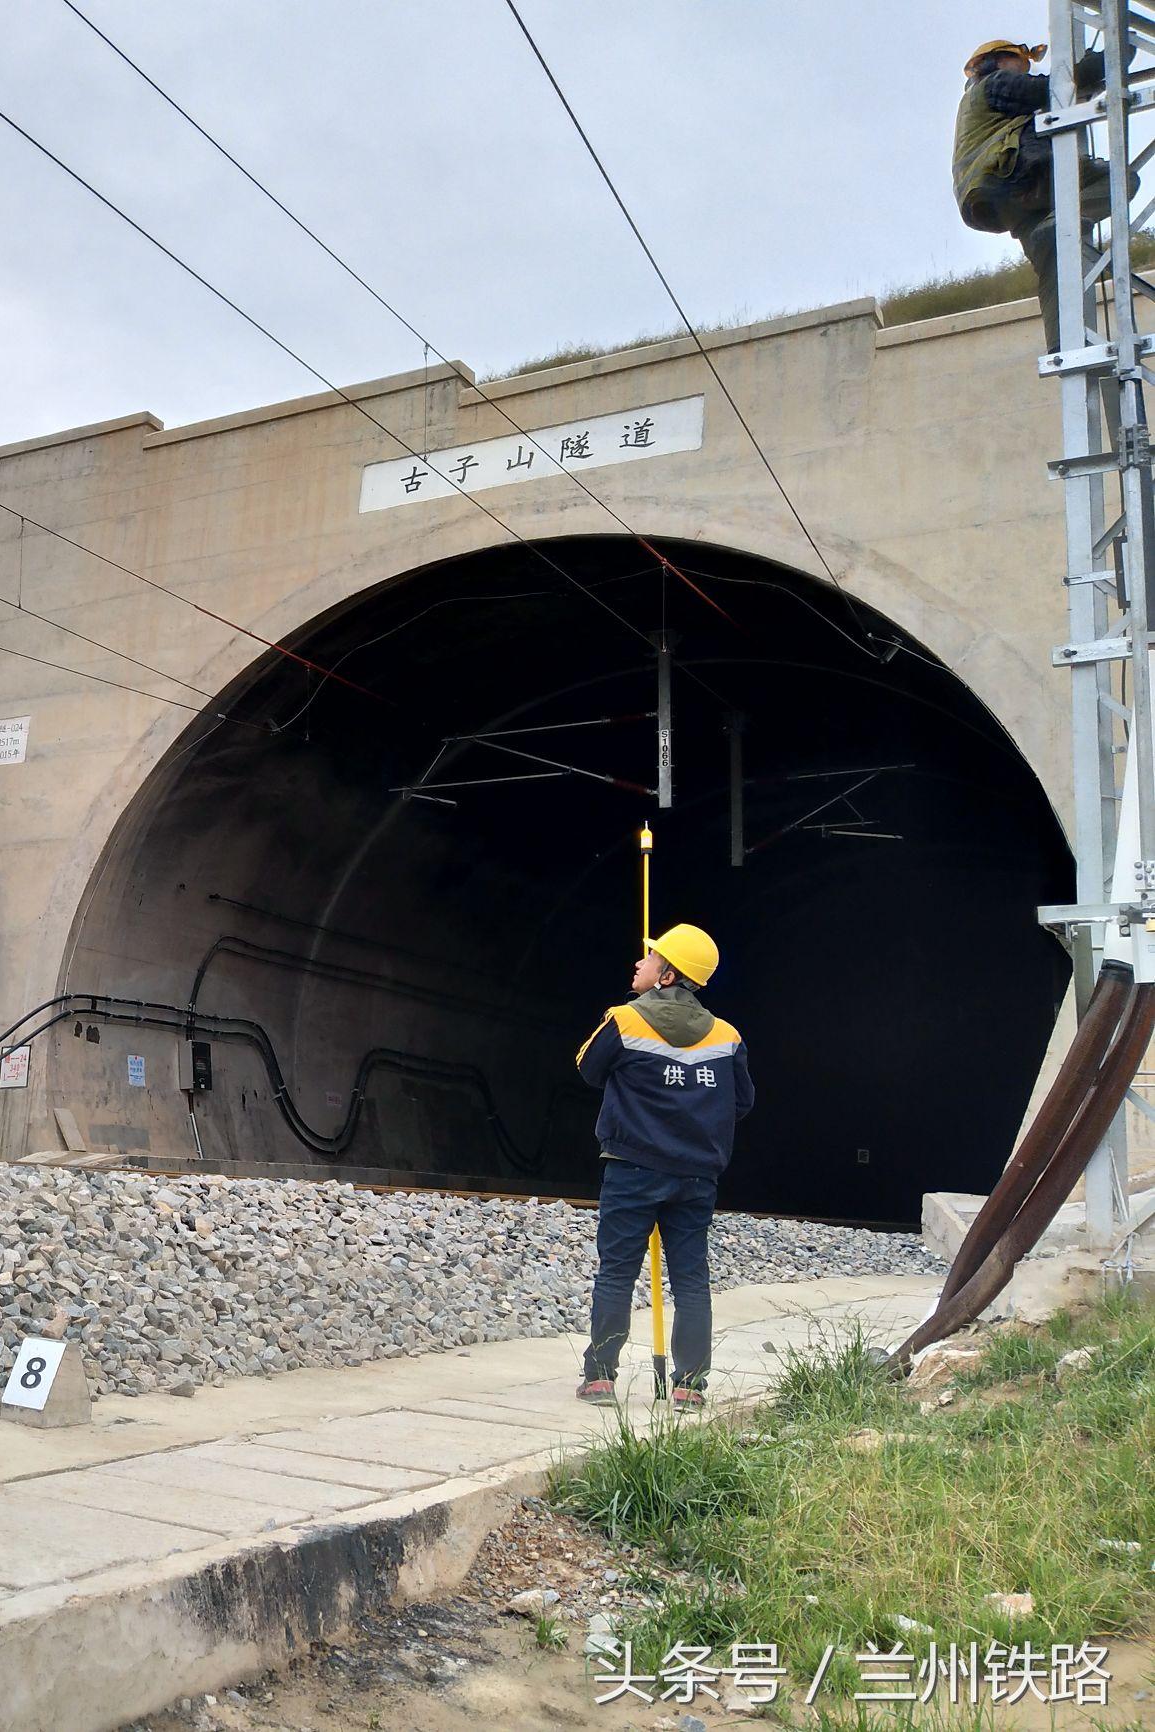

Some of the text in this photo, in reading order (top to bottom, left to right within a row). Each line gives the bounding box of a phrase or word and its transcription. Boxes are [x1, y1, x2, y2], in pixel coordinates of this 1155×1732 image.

[400, 417, 656, 495] 古子山隧道
[661, 730, 669, 767] S1066
[663, 1064, 718, 1088] 供电
[20, 1356, 47, 1389] 8
